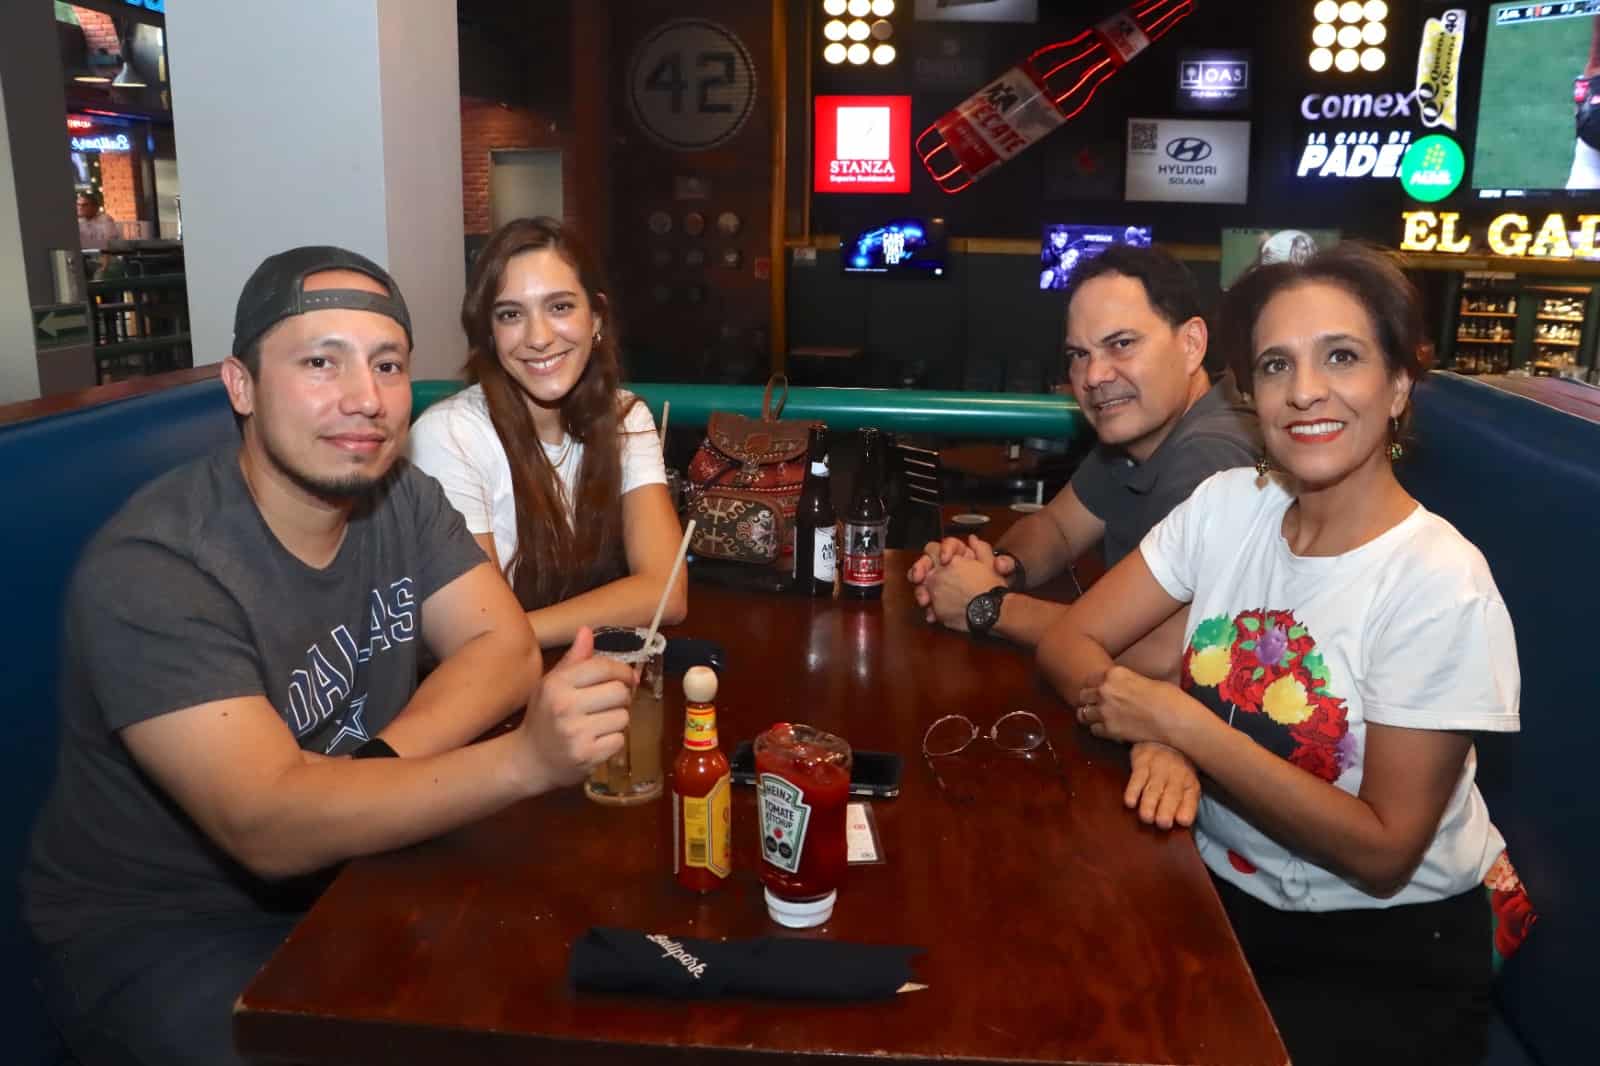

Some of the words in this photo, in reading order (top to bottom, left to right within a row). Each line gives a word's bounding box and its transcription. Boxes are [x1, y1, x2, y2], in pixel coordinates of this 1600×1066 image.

[646, 51, 736, 113] 42
[1301, 89, 1417, 120] comex
[1308, 132, 1326, 144] LA
[1335, 131, 1378, 144] CASA
[1388, 130, 1411, 144] DE
[830, 160, 895, 174] STANZA
[1296, 144, 1412, 177] PADE
[1400, 211, 1472, 253] EL
[765, 784, 792, 803] HEINZ
[645, 933, 708, 979] Ballpark
